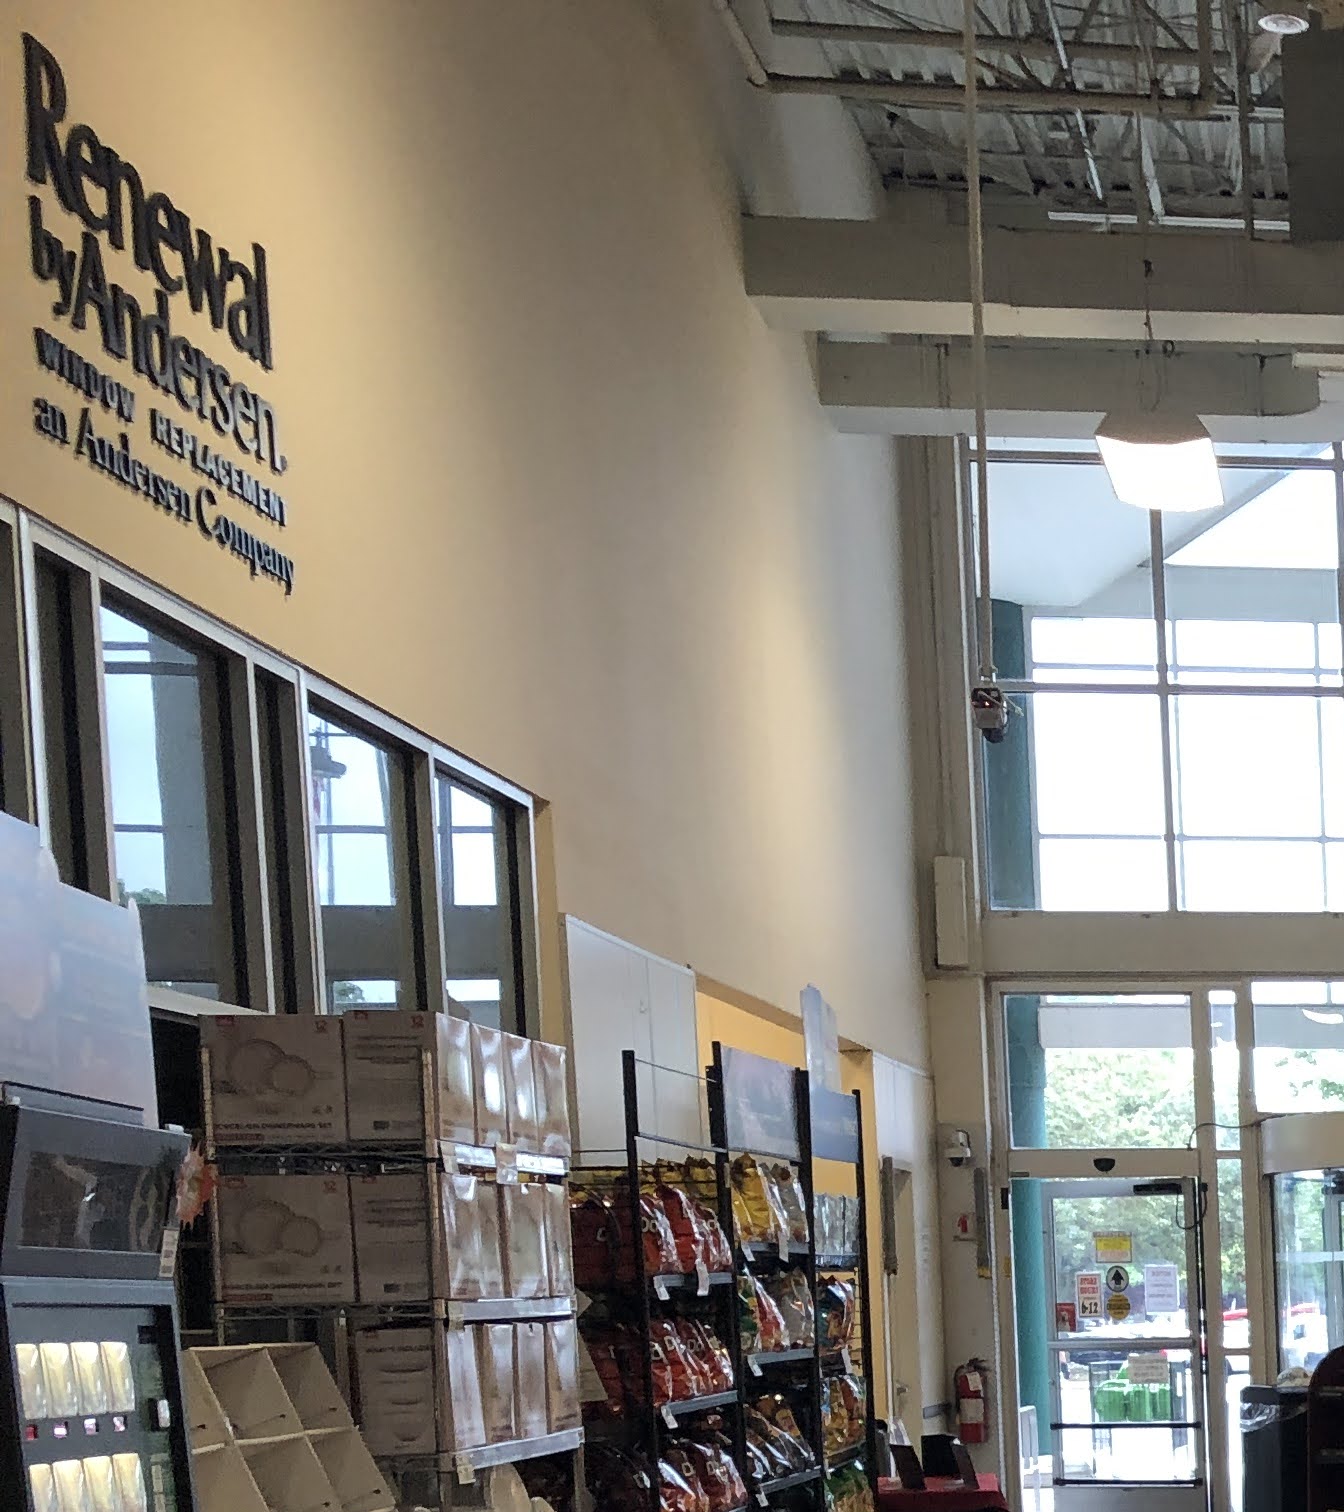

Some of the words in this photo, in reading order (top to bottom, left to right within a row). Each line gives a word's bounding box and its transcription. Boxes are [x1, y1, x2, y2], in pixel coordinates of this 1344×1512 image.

[22, 32, 273, 370] Renewal
[33, 327, 135, 423] WINDOW
[150, 407, 287, 527] REPLACEMENT
[33, 397, 69, 444] an
[76, 407, 193, 527] Andersen
[196, 485, 294, 596] Company
